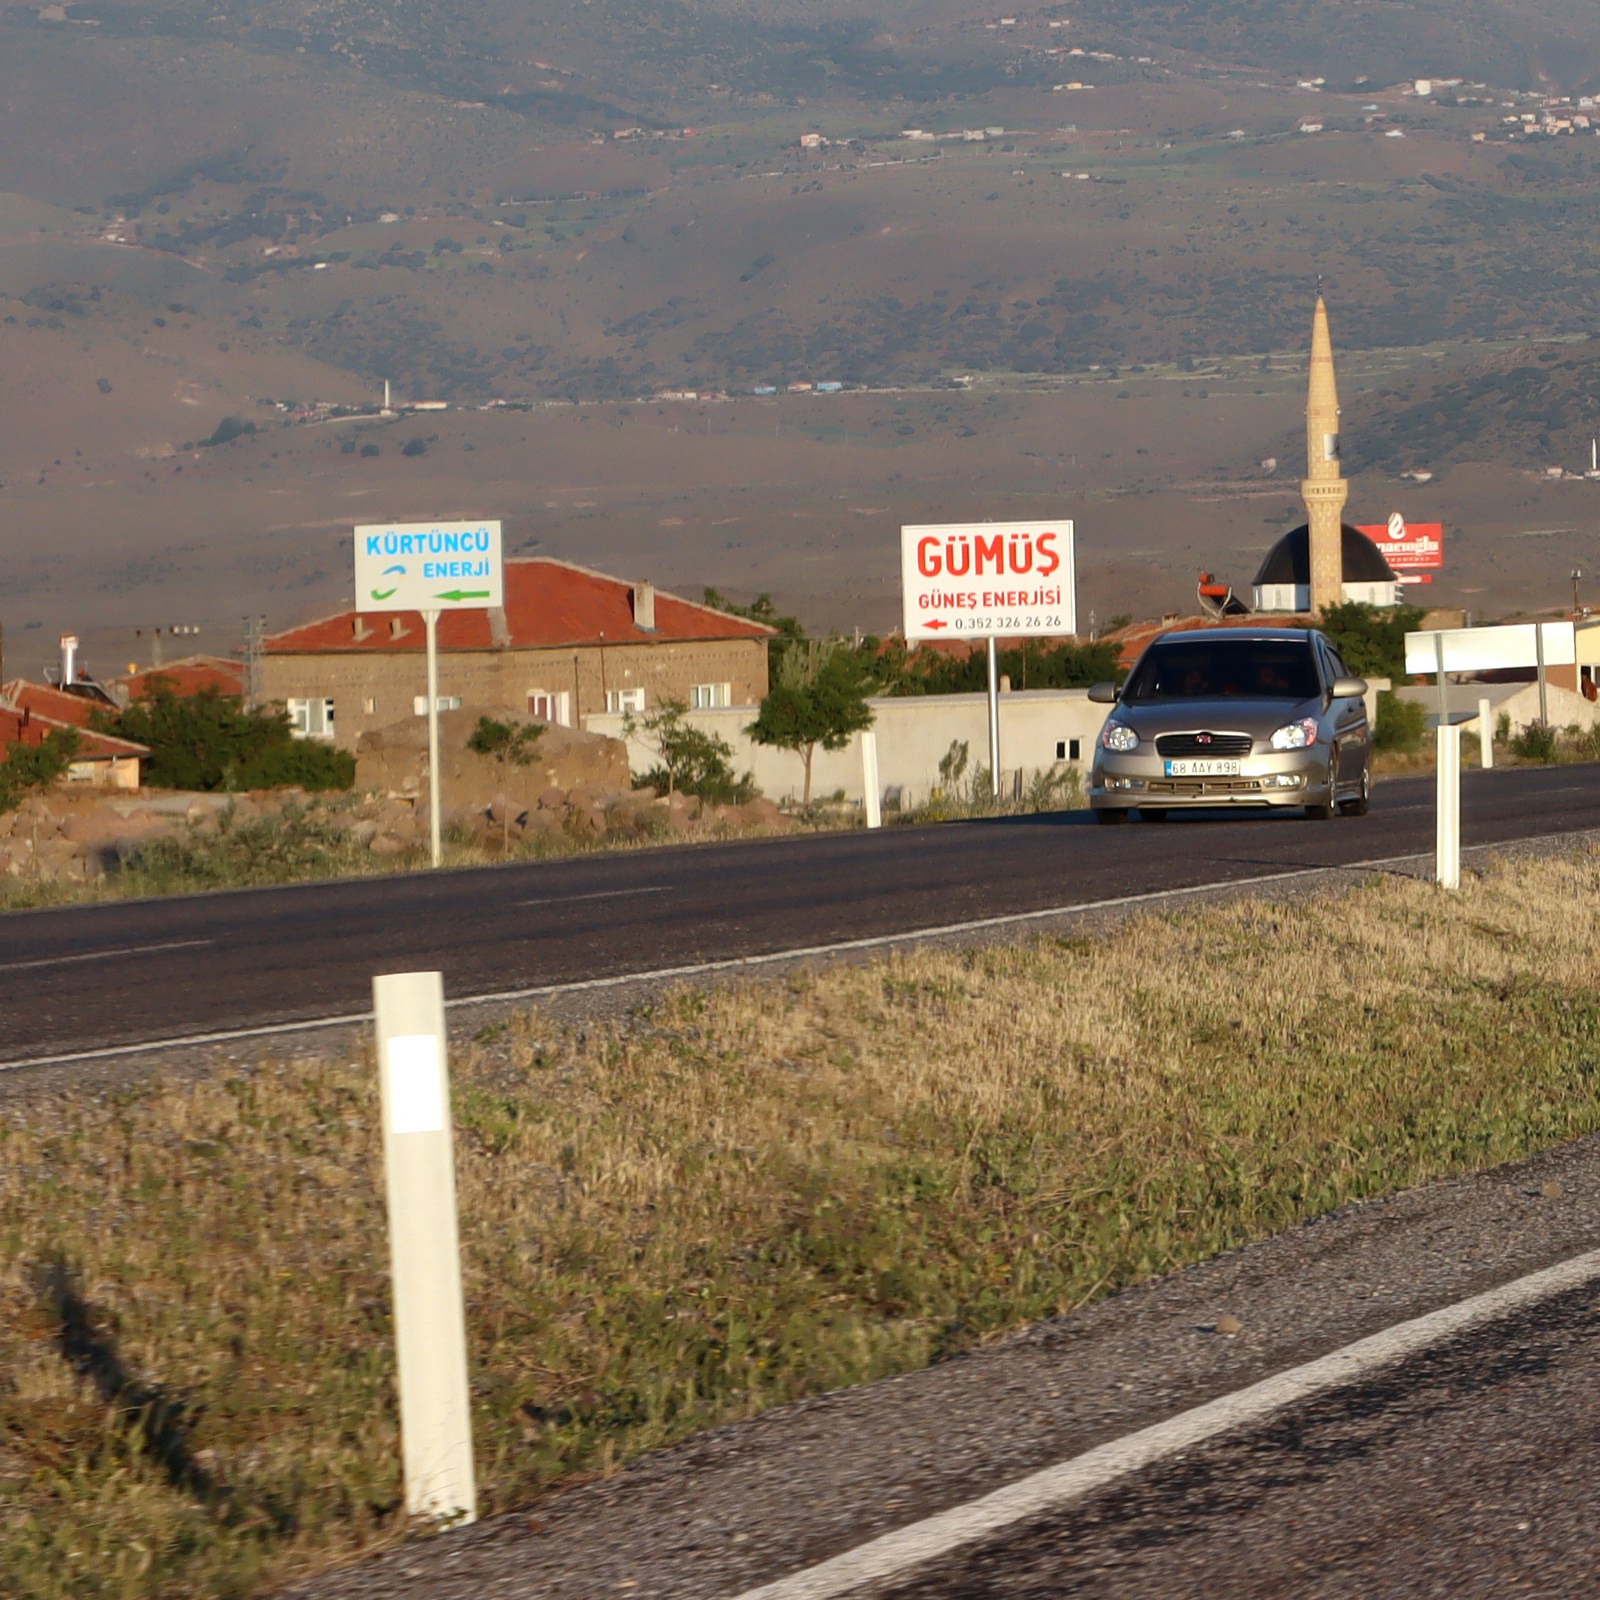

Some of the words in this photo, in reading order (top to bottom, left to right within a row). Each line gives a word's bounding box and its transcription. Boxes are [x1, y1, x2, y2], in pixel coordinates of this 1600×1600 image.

[366, 528, 489, 556] KÜRTÜNCÜ
[917, 532, 1060, 578] GÜMÜŞ
[423, 558, 490, 578] ENERJİ
[918, 589, 977, 609] GÜNEŞ
[982, 585, 1061, 607] ENERJİSİ
[955, 617, 992, 630] 0.352
[997, 616, 1021, 629] 326
[1025, 616, 1041, 628] 26
[1046, 615, 1061, 627] 26
[1172, 762, 1186, 774] 68
[1191, 762, 1212, 773] AAY
[1216, 761, 1238, 773] 898
